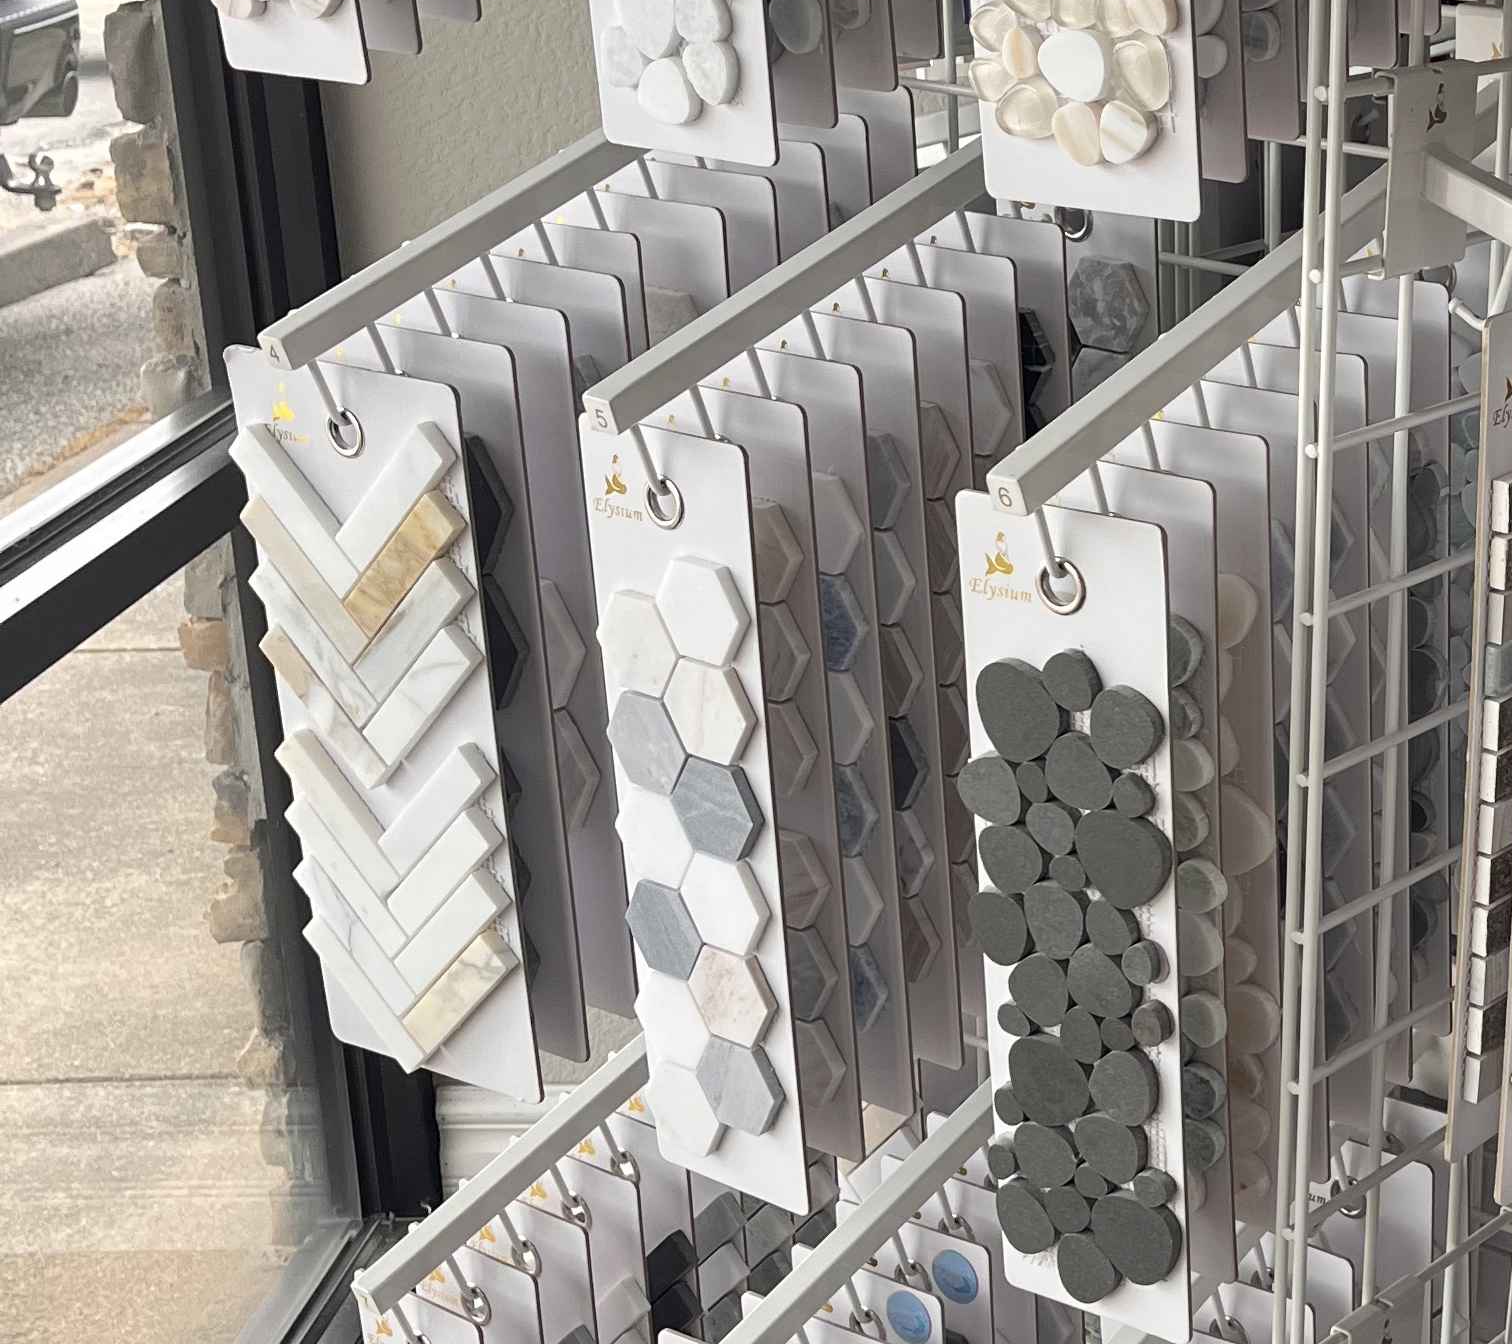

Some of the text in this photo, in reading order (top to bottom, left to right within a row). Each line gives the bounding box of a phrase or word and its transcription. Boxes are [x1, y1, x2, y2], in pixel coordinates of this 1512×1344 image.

[270, 345, 280, 362] 4
[595, 409, 608, 428] 5
[998, 487, 1012, 507] 6
[594, 497, 643, 521] Elysium
[969, 576, 1032, 602] Elysium
